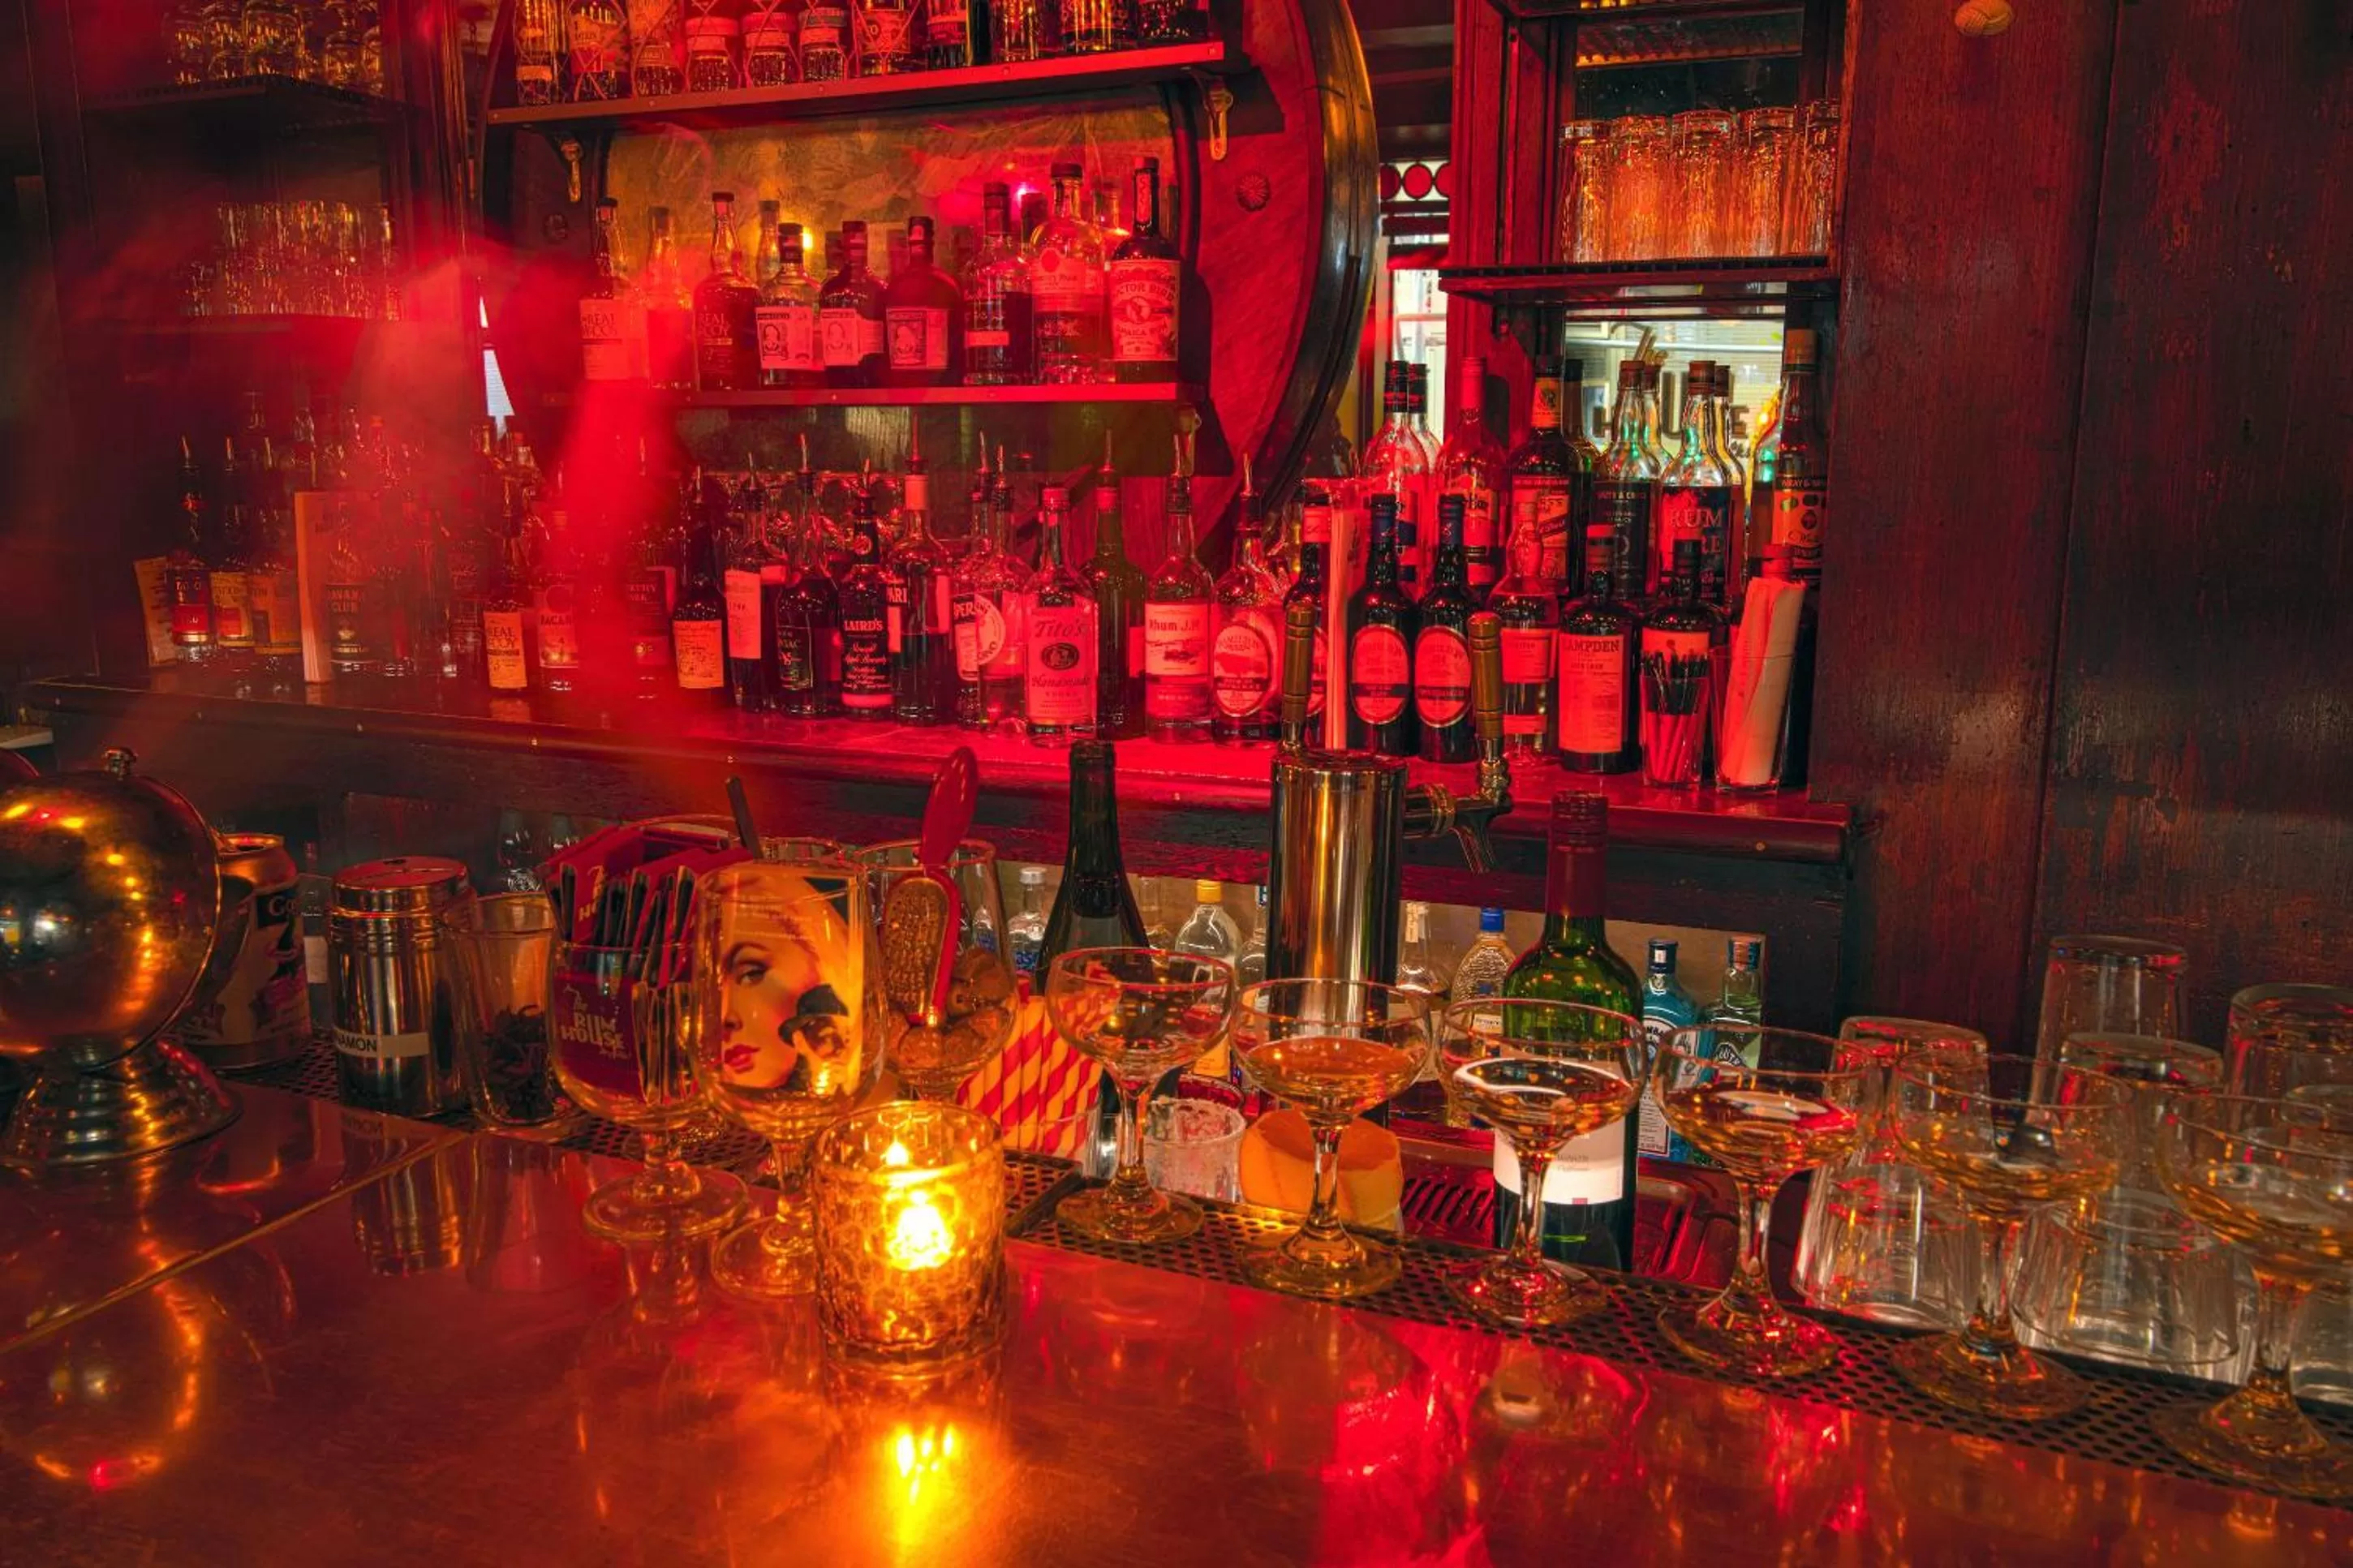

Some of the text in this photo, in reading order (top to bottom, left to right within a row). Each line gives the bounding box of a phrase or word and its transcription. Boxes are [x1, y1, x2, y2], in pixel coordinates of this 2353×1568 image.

[1671, 508, 1723, 529] RUM
[844, 617, 884, 632] LAIRD'S
[1035, 618, 1084, 638] Tito's
[1149, 619, 1178, 631] Rhum
[561, 1016, 624, 1049] HOUSE
